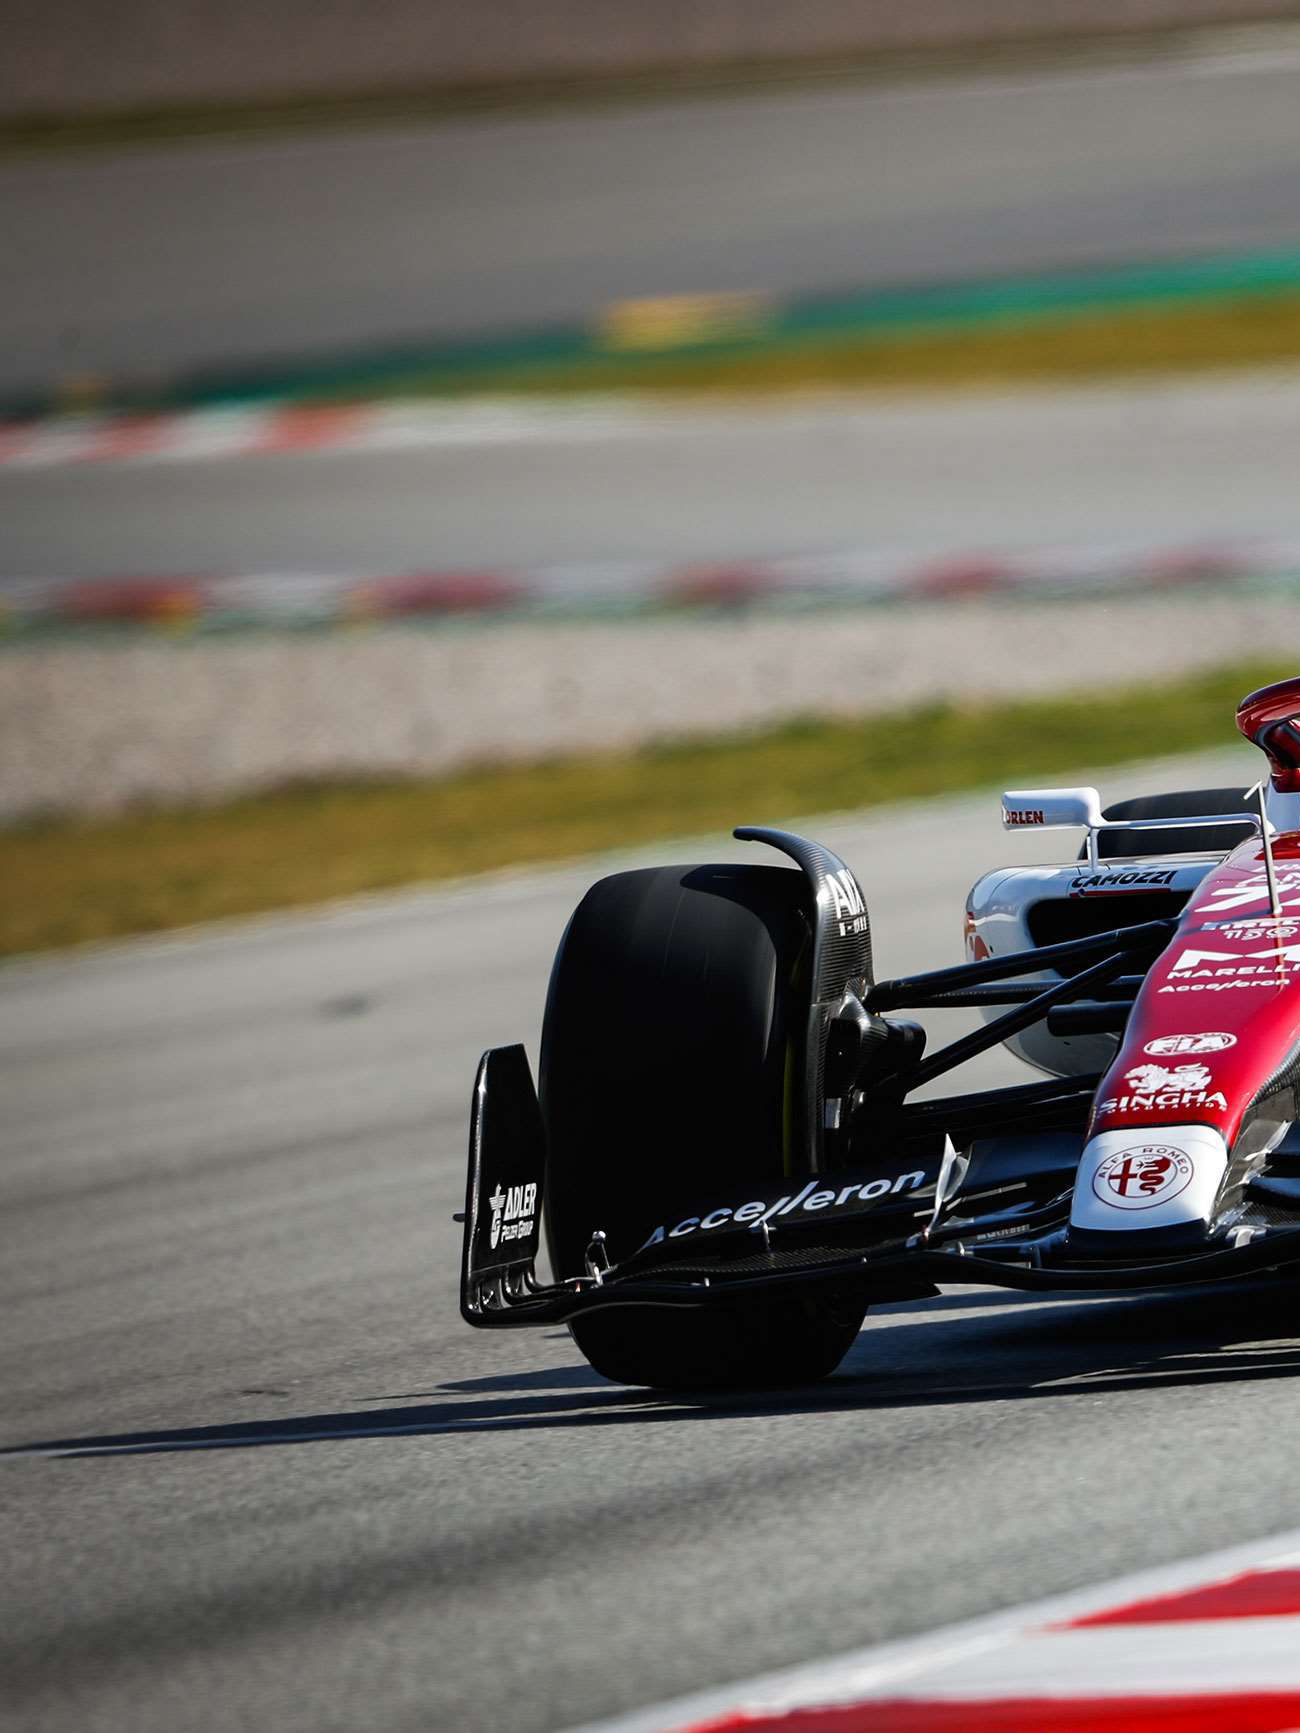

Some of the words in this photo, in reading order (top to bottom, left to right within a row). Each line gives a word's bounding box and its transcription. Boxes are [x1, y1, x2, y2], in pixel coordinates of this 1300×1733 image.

[1071, 870, 1178, 888] CAMOZZI
[1150, 1036, 1225, 1053] FIA
[1098, 1092, 1228, 1113] SINGHA
[1097, 1152, 1133, 1179] ALFA
[1142, 1147, 1189, 1174] ROMEO
[503, 1182, 537, 1221] ADLER
